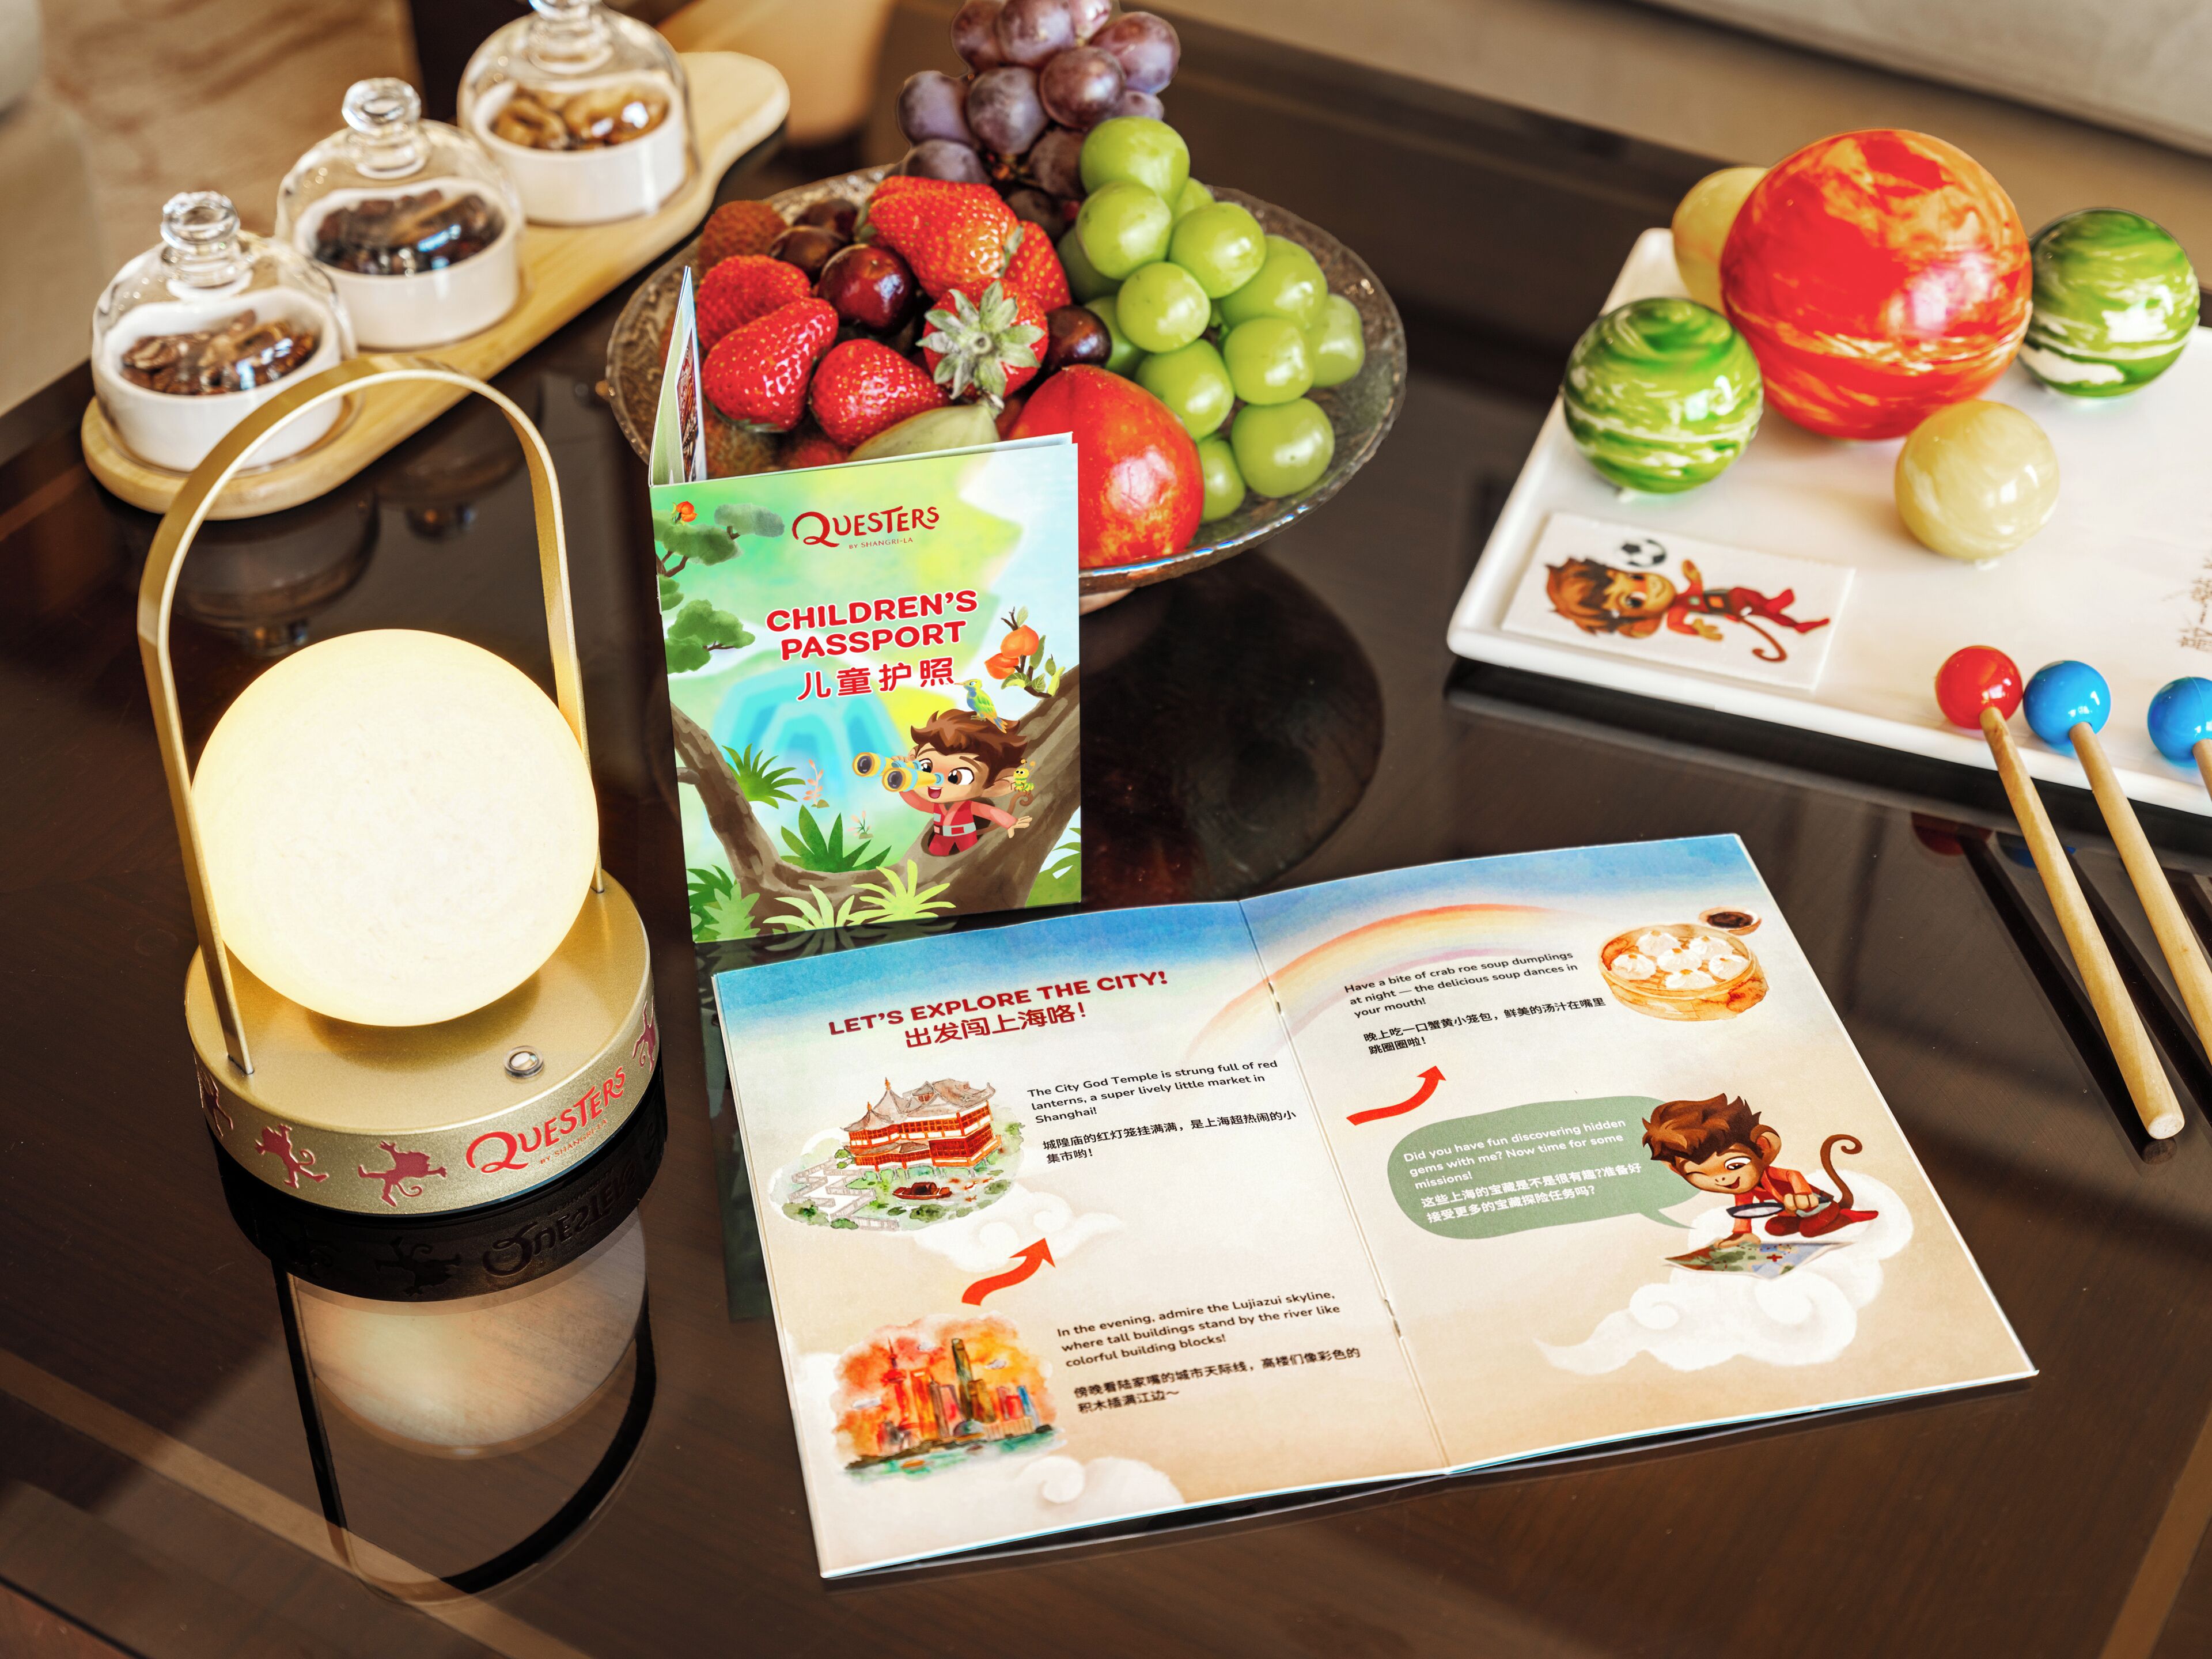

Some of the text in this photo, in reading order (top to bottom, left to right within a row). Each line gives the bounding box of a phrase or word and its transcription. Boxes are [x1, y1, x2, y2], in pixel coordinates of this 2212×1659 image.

[792, 506, 940, 547] QUESTERS
[861, 537, 914, 548] SHANGRI-LA
[781, 620, 967, 661] PASSPORT
[797, 657, 955, 701] 儿童护照
[1343, 982, 1376, 994] Have
[1388, 975, 1412, 984] bite
[1414, 971, 1426, 980] of
[1429, 967, 1456, 977] crab
[1458, 965, 1478, 973] roe
[1480, 961, 1509, 969] soup
[1512, 953, 1574, 965] dumplings
[1350, 997, 1363, 1005] at
[1365, 990, 1397, 1002] night
[1414, 984, 1435, 993] the
[1437, 976, 1490, 989] delicious
[1491, 972, 1521, 981] soup
[1523, 967, 1565, 976] dances
[910, 989, 1032, 1021] EXPLORE
[1036, 980, 1090, 1000] THE
[1096, 971, 1168, 991] CITY!
[1354, 997, 1426, 1019] your mouth!
[1027, 1060, 1278, 1097] The City God Temple is strung full of red
[1031, 1097, 1087, 1111] lanterns,
[1100, 1089, 1135, 1100] super
[1138, 1084, 1172, 1094] lively
[1174, 1080, 1205, 1090] little
[1207, 1075, 1252, 1087] market
[1253, 1074, 1266, 1082] in
[465, 1066, 626, 1173] QUESTERS
[1035, 1106, 1097, 1124] Shanghai!
[540, 1119, 608, 1165] BY SHANGRI-LA
[1403, 1120, 1626, 1162] Did you have fun discovering hidden
[1409, 1135, 1624, 1177] gems with me? Now time for some
[1414, 1171, 1473, 1190] missions!
[1056, 1291, 1335, 1338] In the evening, admire the Lujiazui skyline,
[1061, 1305, 1340, 1352] where tall buildings stand by the river like
[1065, 1334, 1226, 1368] colorful building blocks!
